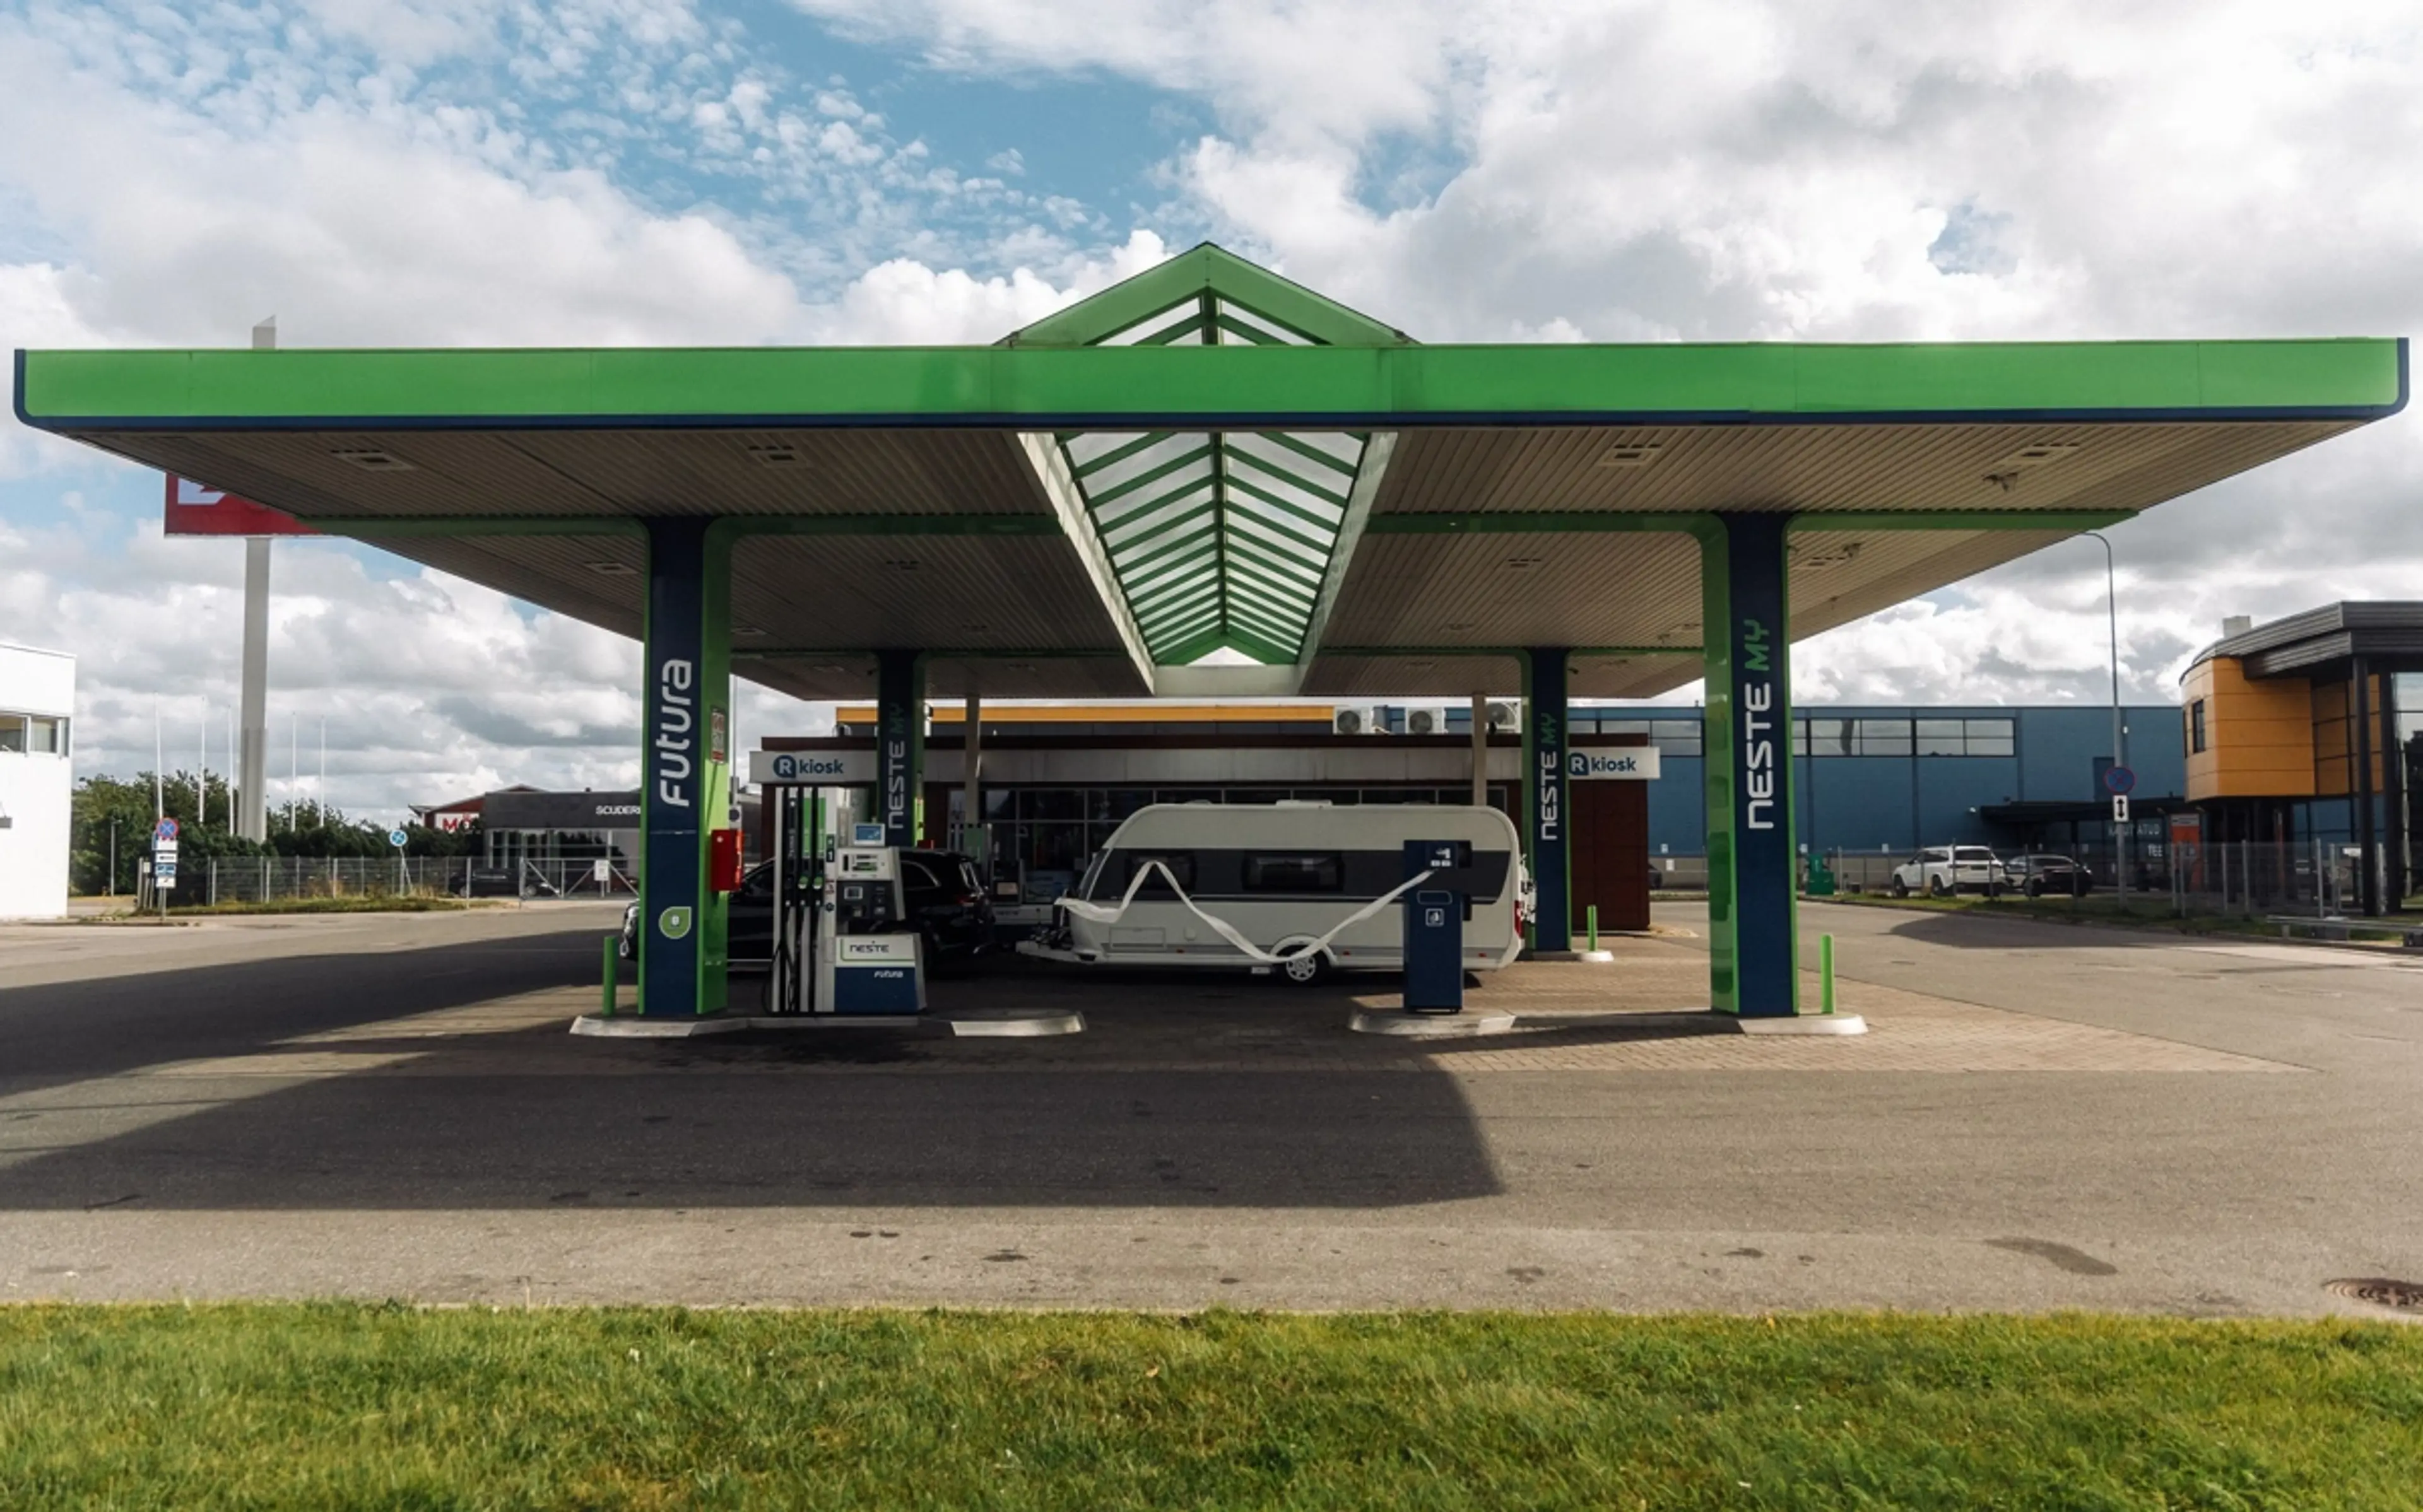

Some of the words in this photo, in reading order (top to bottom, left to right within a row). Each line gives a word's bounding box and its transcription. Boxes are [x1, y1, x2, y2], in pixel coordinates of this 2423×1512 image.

[1743, 619, 1770, 671] MY
[888, 702, 905, 734] MY
[1540, 712, 1557, 746] MY
[779, 758, 793, 775] R
[799, 758, 844, 774] kiosk
[1571, 757, 1585, 773] R
[1591, 756, 1637, 772] kiosk
[1745, 682, 1774, 829] NESTE
[888, 740, 905, 829] NESTE
[1540, 751, 1558, 840] NESTE
[849, 944, 890, 953] NESTE
